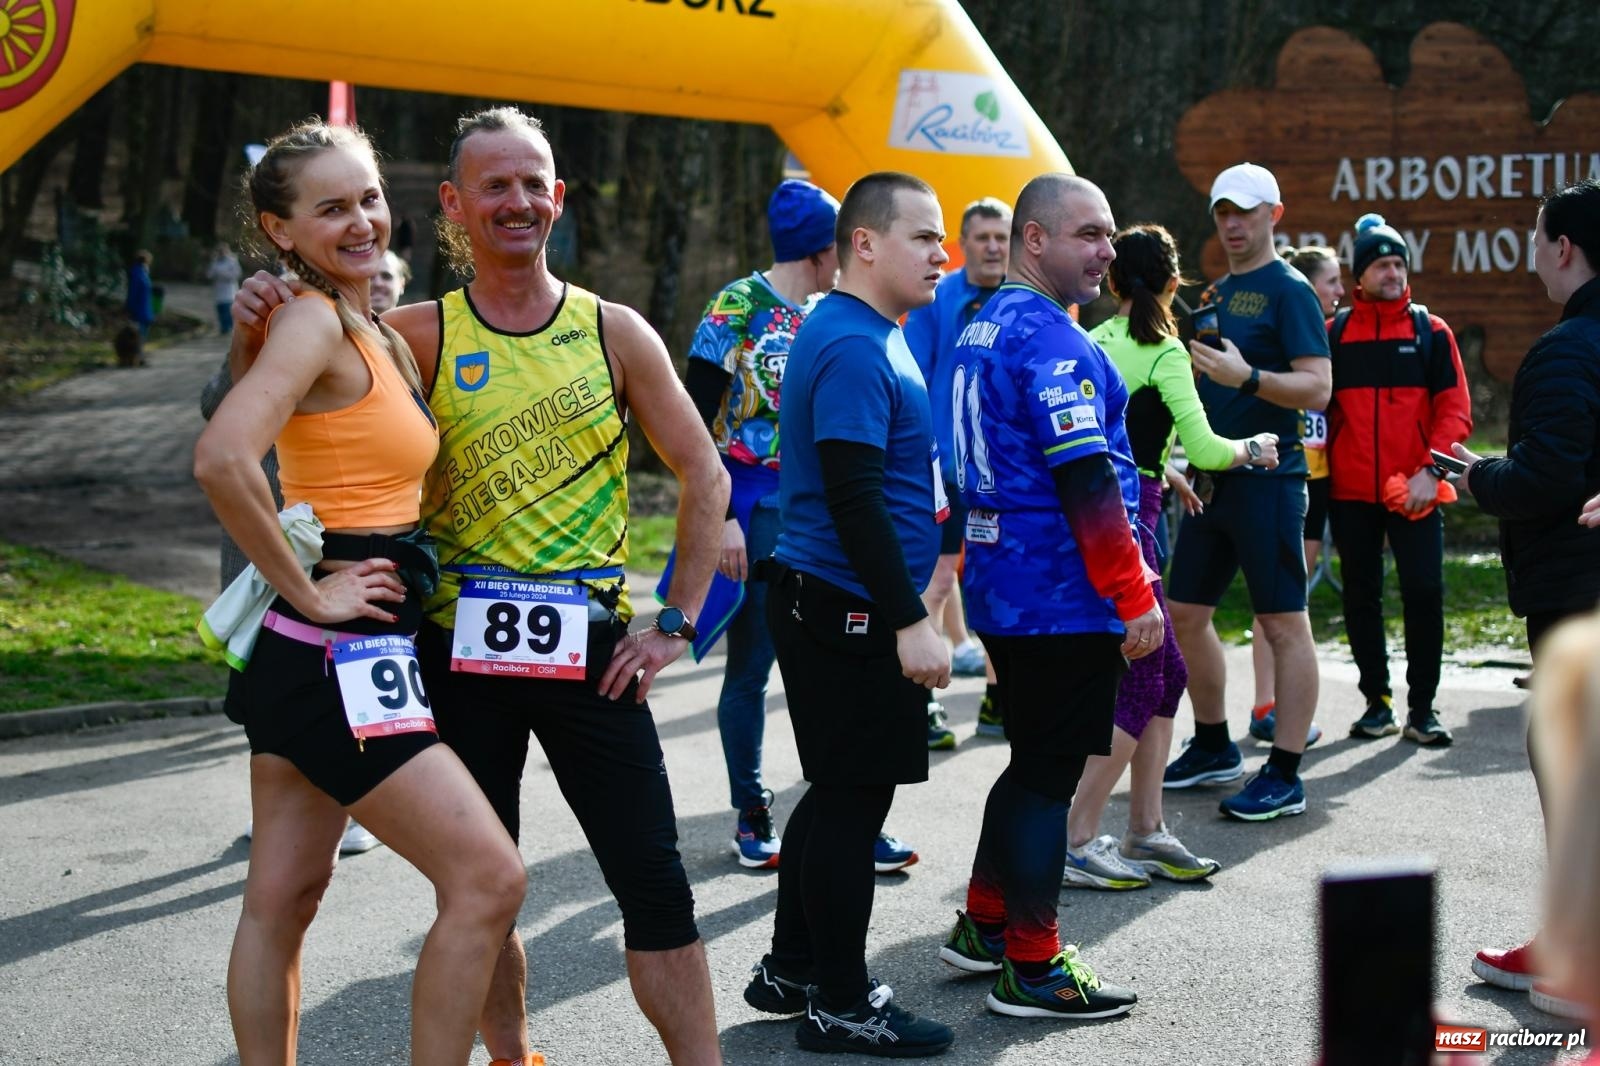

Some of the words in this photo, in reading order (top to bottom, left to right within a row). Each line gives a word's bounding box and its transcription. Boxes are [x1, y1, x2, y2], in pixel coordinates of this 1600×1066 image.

[450, 436, 577, 535] BIEGAJĄ
[474, 581, 487, 590] XII
[487, 581, 510, 591] BIEG
[511, 583, 574, 596] TWARDZIELA
[508, 592, 530, 600] lutego
[484, 602, 562, 655] 89
[349, 643, 363, 652] XII
[365, 638, 387, 649] BIEG
[492, 663, 530, 673] Racibórz
[371, 658, 430, 710] 90
